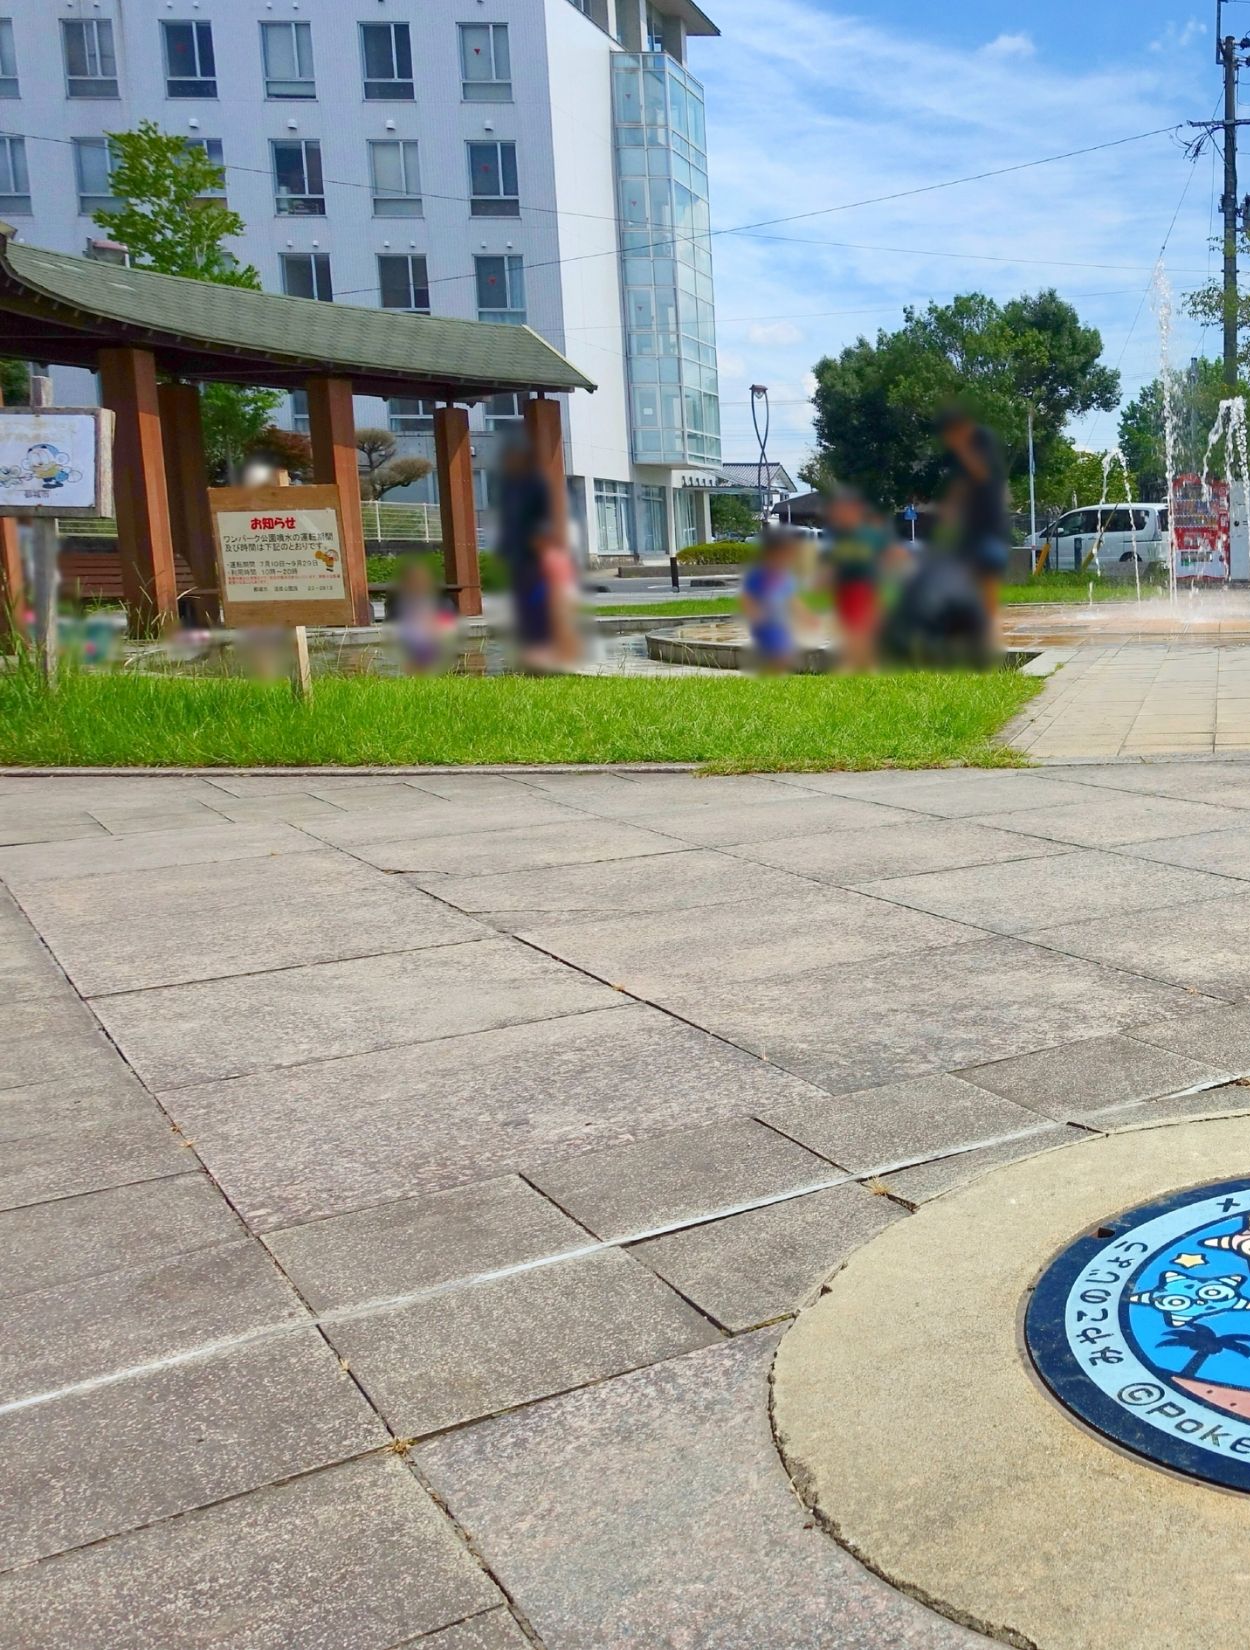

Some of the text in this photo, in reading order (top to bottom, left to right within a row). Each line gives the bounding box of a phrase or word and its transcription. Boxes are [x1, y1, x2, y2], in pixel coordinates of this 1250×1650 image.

[250, 517, 296, 530] お知らせ
[225, 542, 328, 553] 及び時間は下記のとおりです。
[1076, 1240, 1149, 1367] みやこのじょう
